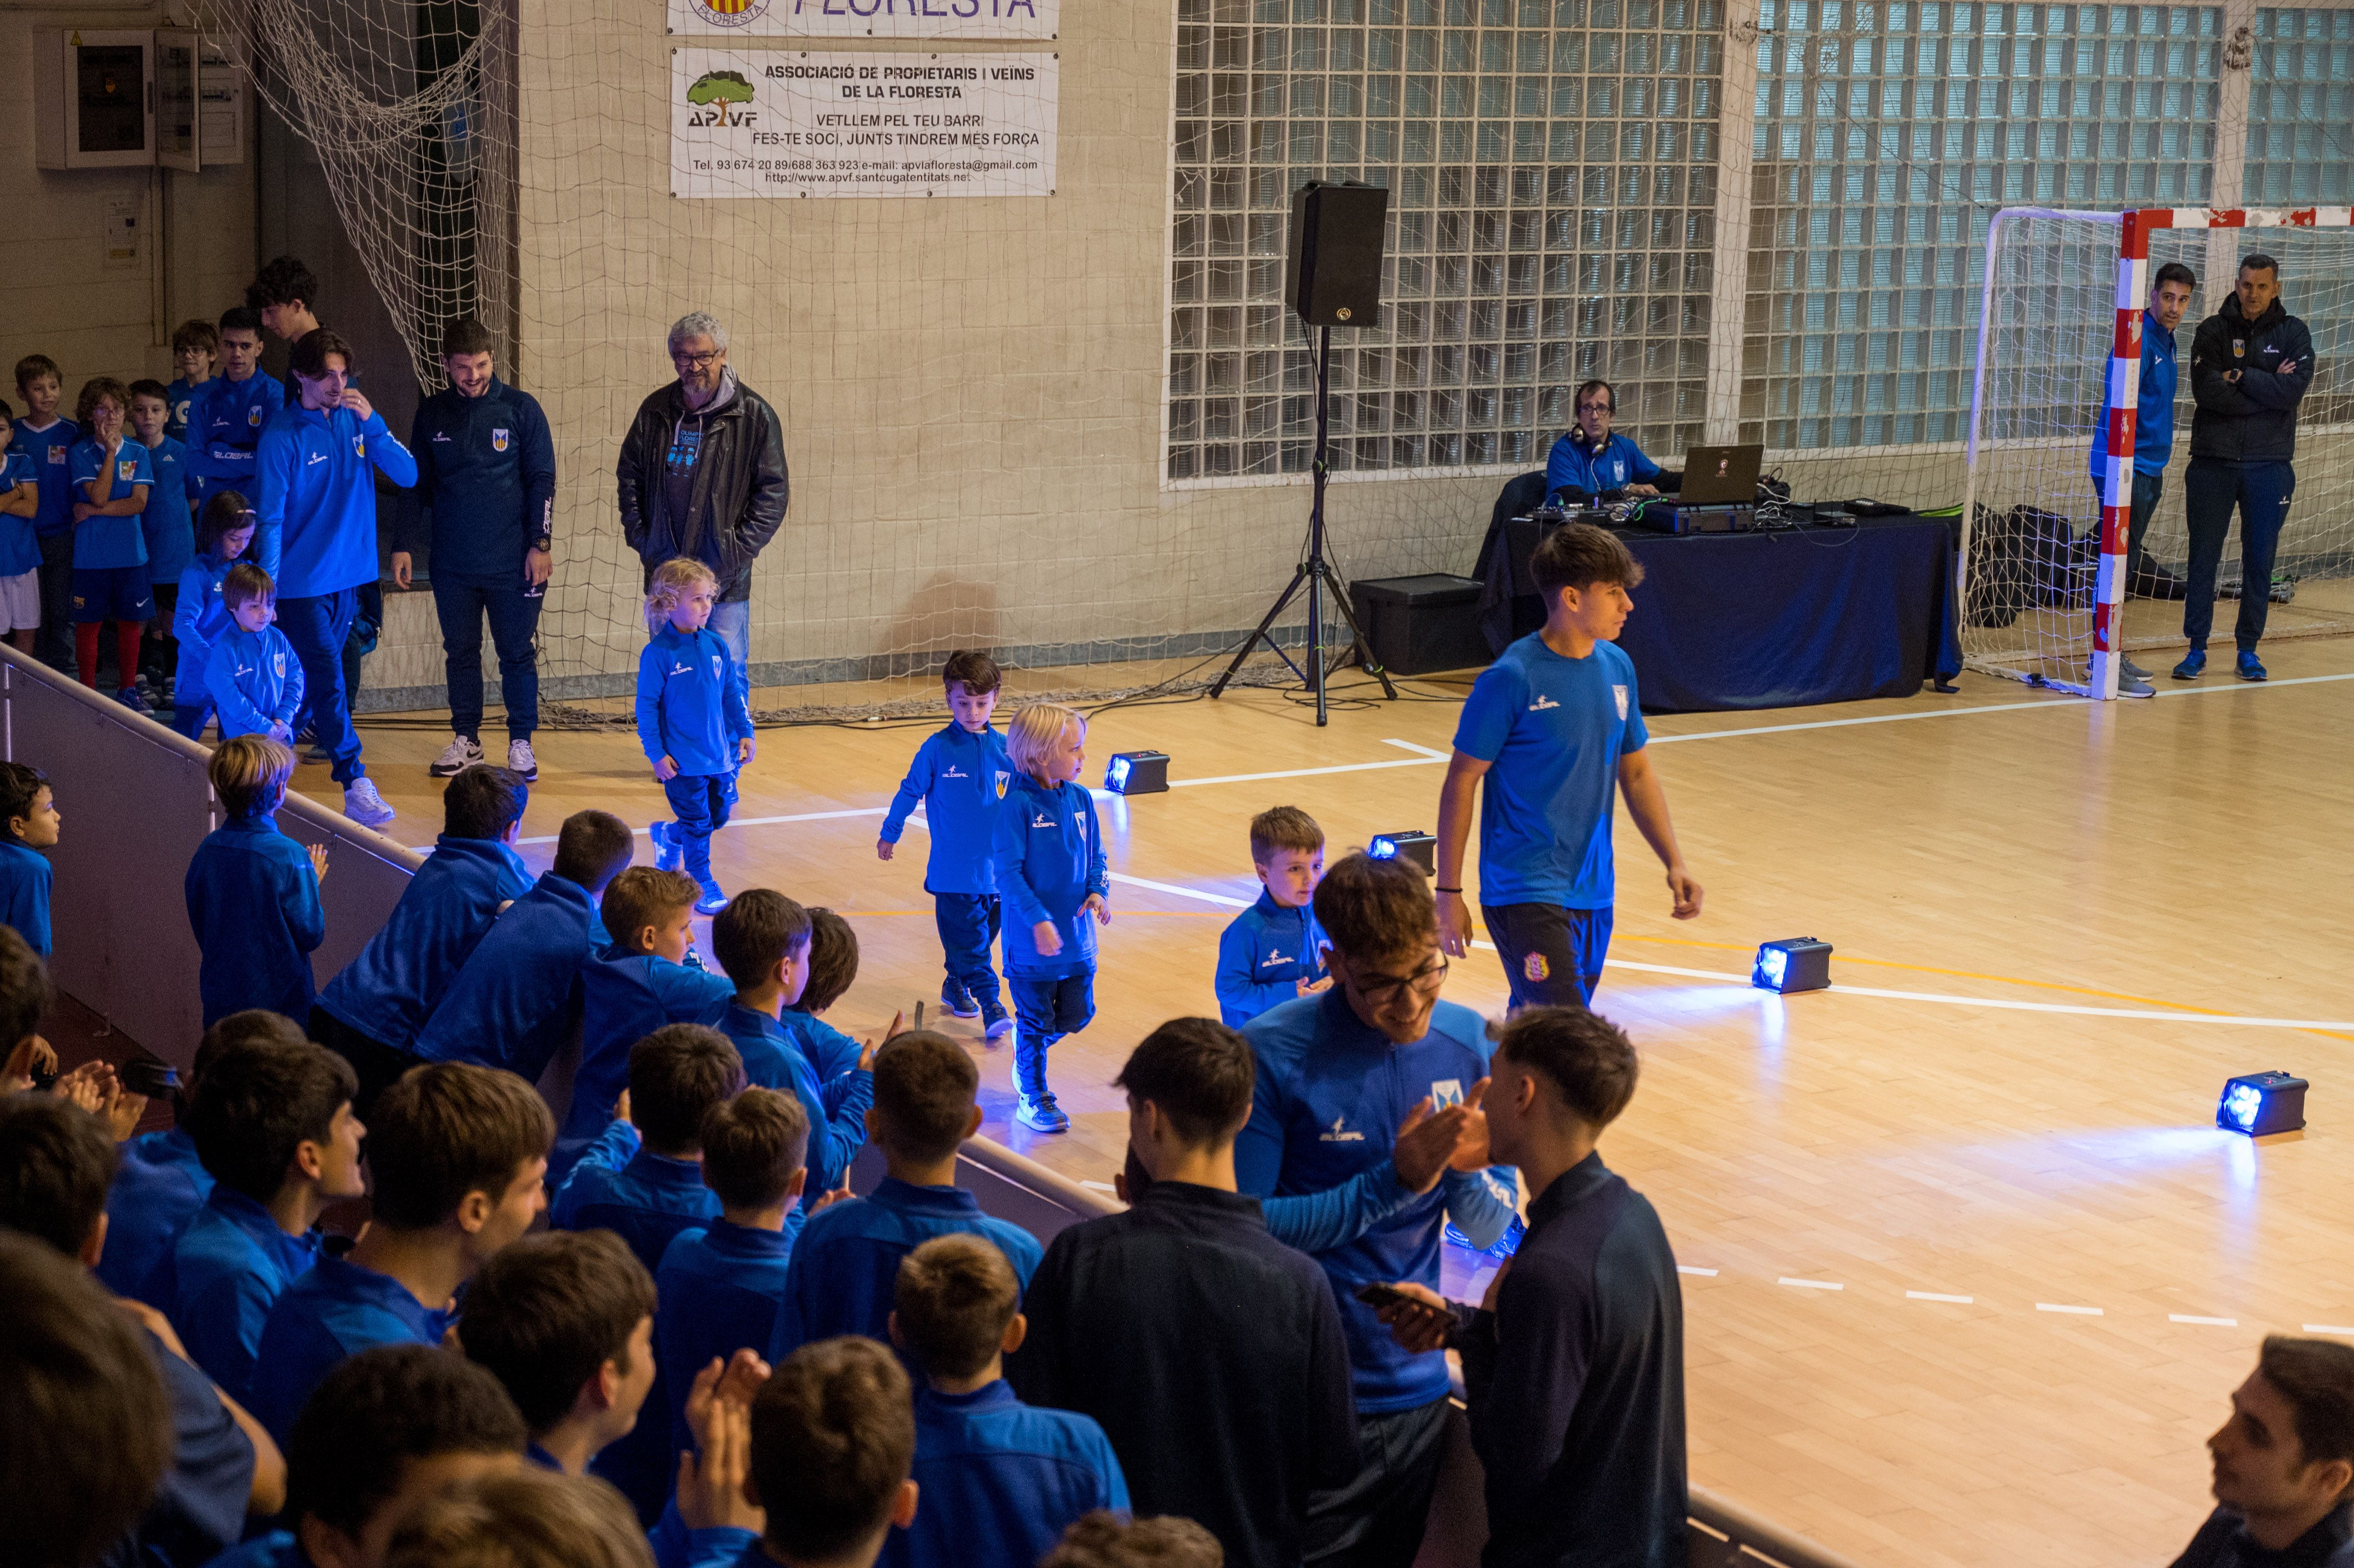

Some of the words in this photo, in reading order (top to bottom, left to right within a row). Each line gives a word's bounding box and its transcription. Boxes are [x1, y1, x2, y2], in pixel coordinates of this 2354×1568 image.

[697, 4, 763, 25] FLORESTA
[765, 64, 854, 79] ASSOCIACIÓ
[859, 67, 878, 79] DE
[884, 67, 977, 80] PROPIETARIS
[982, 68, 986, 80] I
[991, 66, 1035, 80] VEÏNS
[842, 85, 861, 98] DE
[867, 86, 885, 98] LA
[890, 86, 962, 99] FLORESTA
[817, 114, 880, 127] VETLLEM
[884, 115, 909, 127] PEL
[913, 115, 940, 127] TEU
[944, 115, 984, 127] BARRI
[753, 133, 801, 145] FES-TE
[806, 133, 842, 148] SOCI,
[847, 133, 893, 146] JUNTS
[896, 133, 958, 146] TINDREM
[962, 130, 989, 146] MÉS
[993, 133, 1039, 148] FORÇA
[694, 160, 713, 169] Tel.
[717, 160, 730, 169] 93
[734, 160, 754, 169] 674
[758, 160, 771, 169] 20
[775, 160, 812, 169] 89/688
[815, 160, 835, 169] 363
[839, 160, 858, 169] 923
[862, 160, 898, 169] e-mail:
[901, 160, 1038, 172] apvlafloresta@gmail.com
